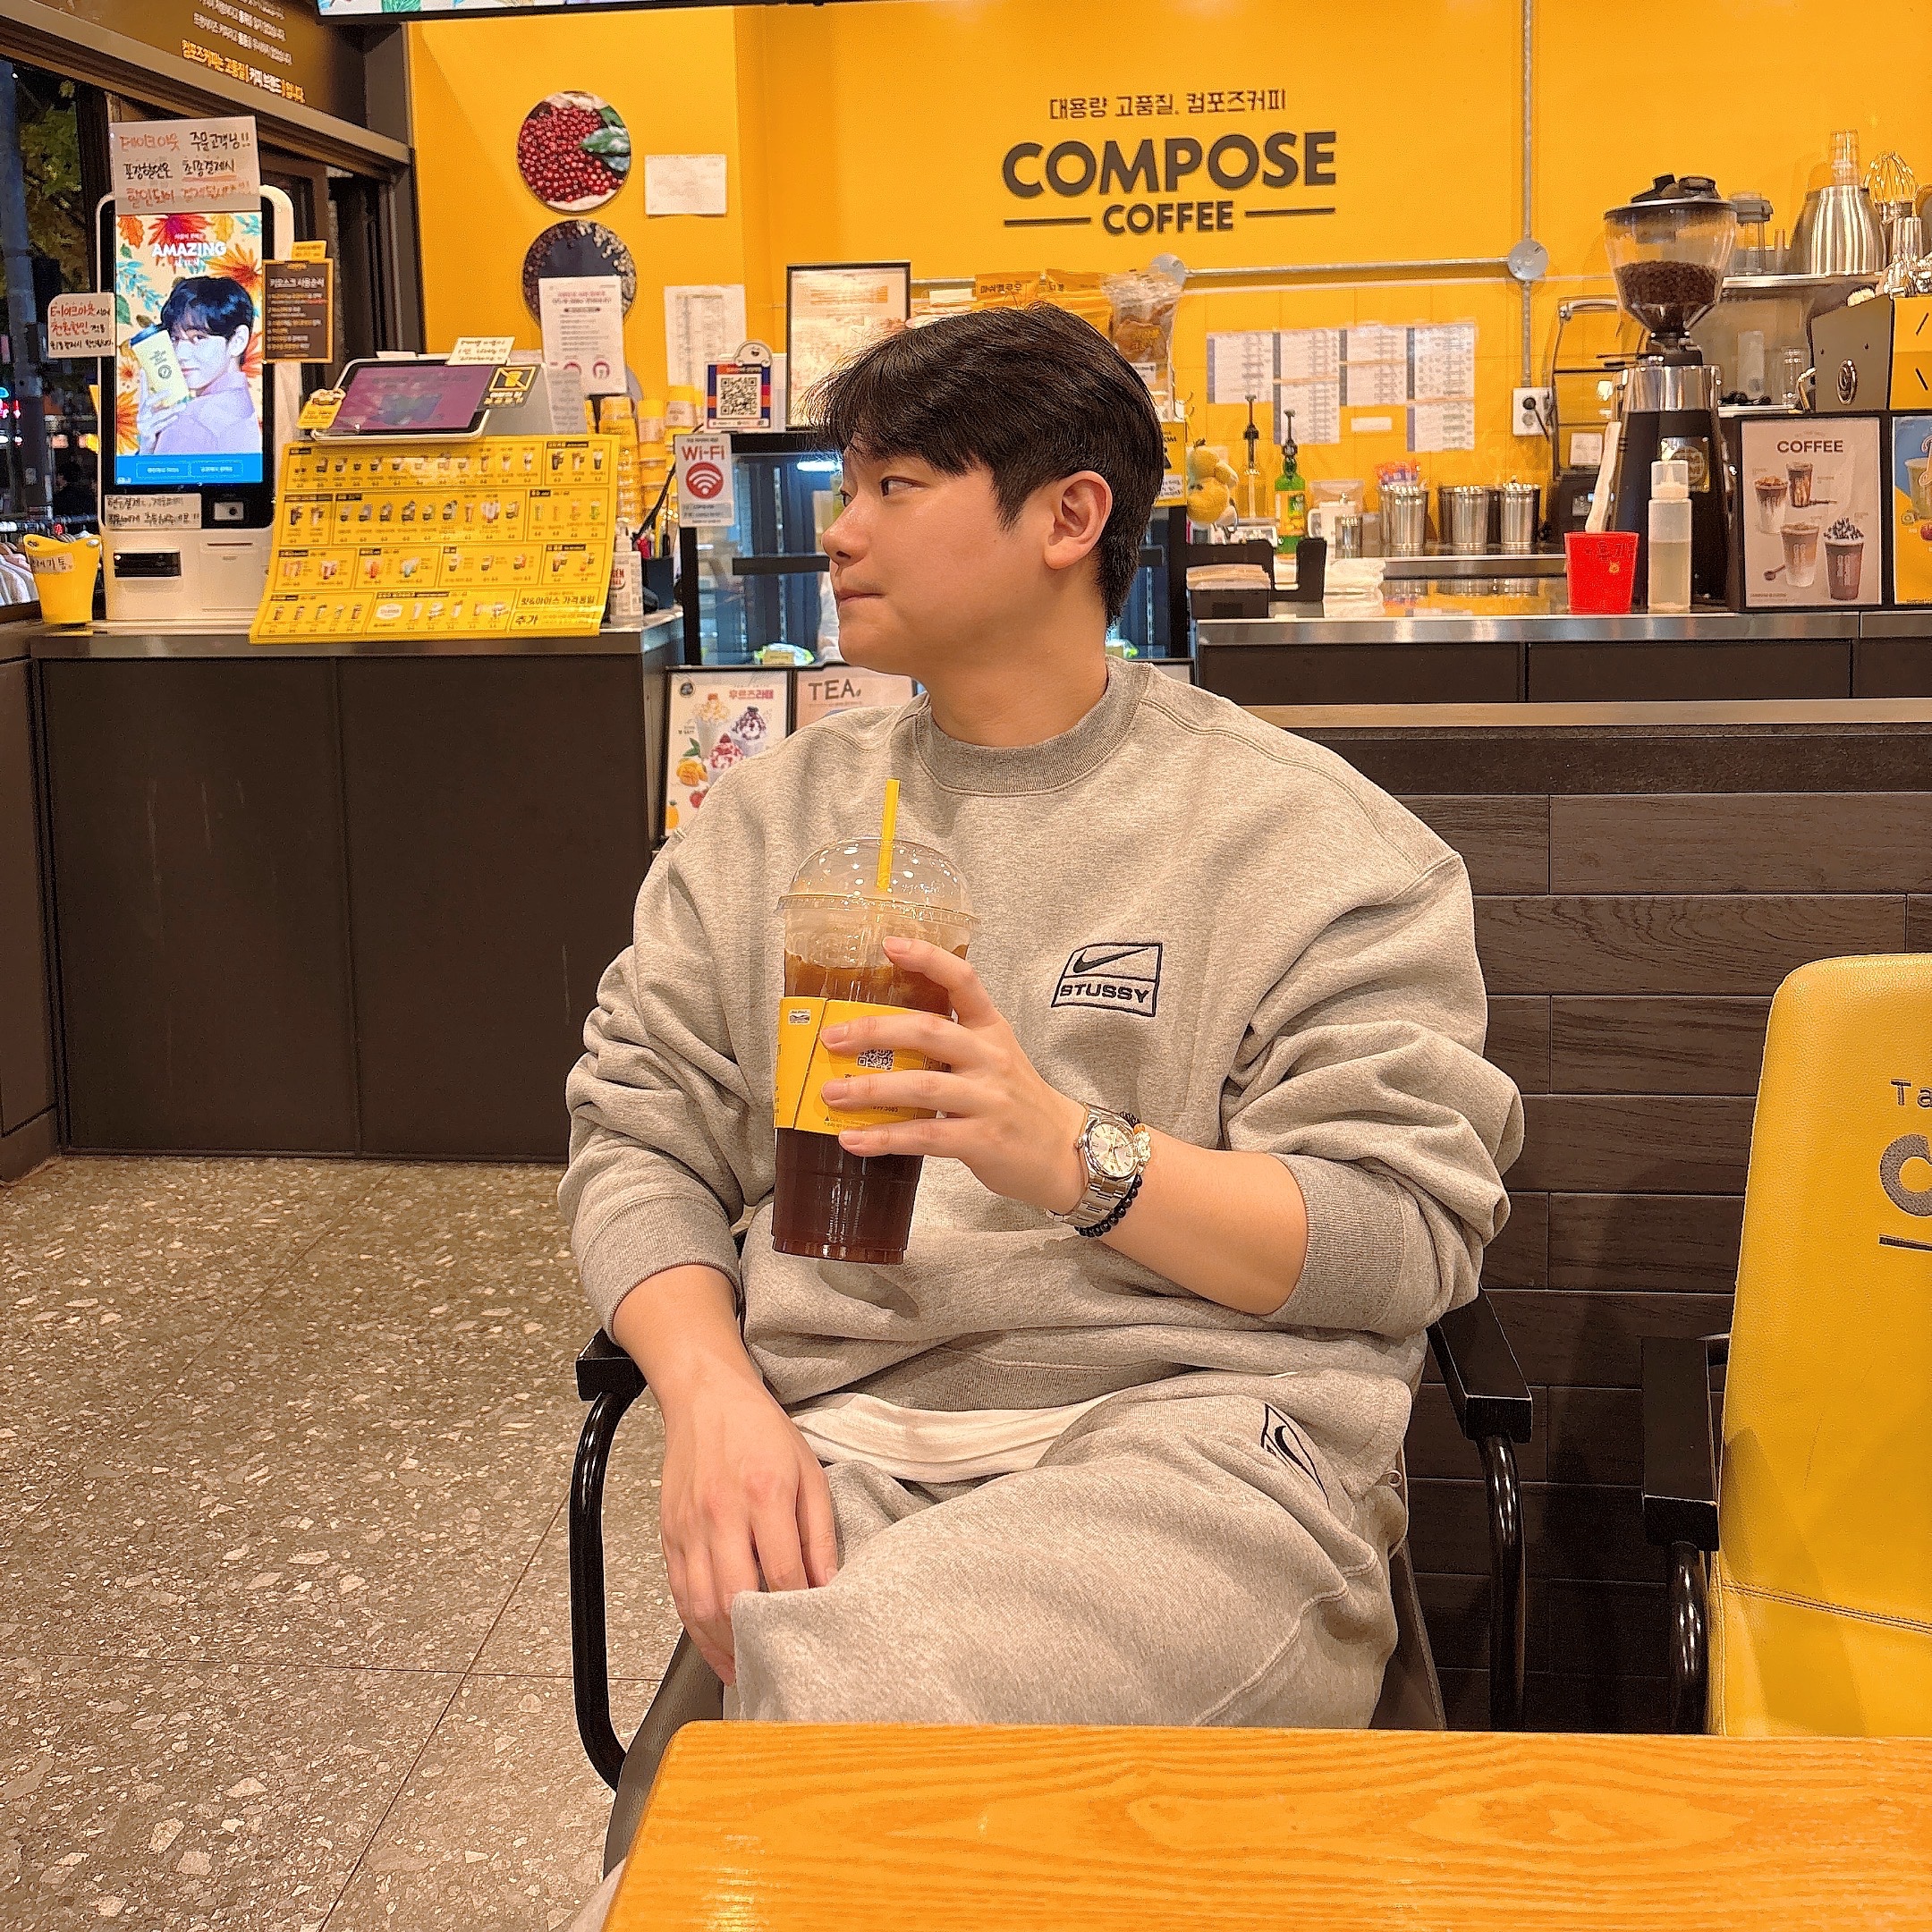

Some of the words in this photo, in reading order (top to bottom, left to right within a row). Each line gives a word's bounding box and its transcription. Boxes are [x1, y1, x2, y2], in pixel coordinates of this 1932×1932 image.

[1049, 97, 1107, 120] 대용량
[1114, 94, 1180, 117] 고품질.
[1186, 89, 1287, 114] 컴포즈커피
[1002, 131, 1336, 199] COMPOSE
[1103, 199, 1233, 235] COFFEE
[152, 242, 227, 258] AMAZING
[682, 445, 725, 462] Wi-Fi
[1776, 439, 1843, 453] COFFEE
[1060, 983, 1150, 1004] STUSSY
